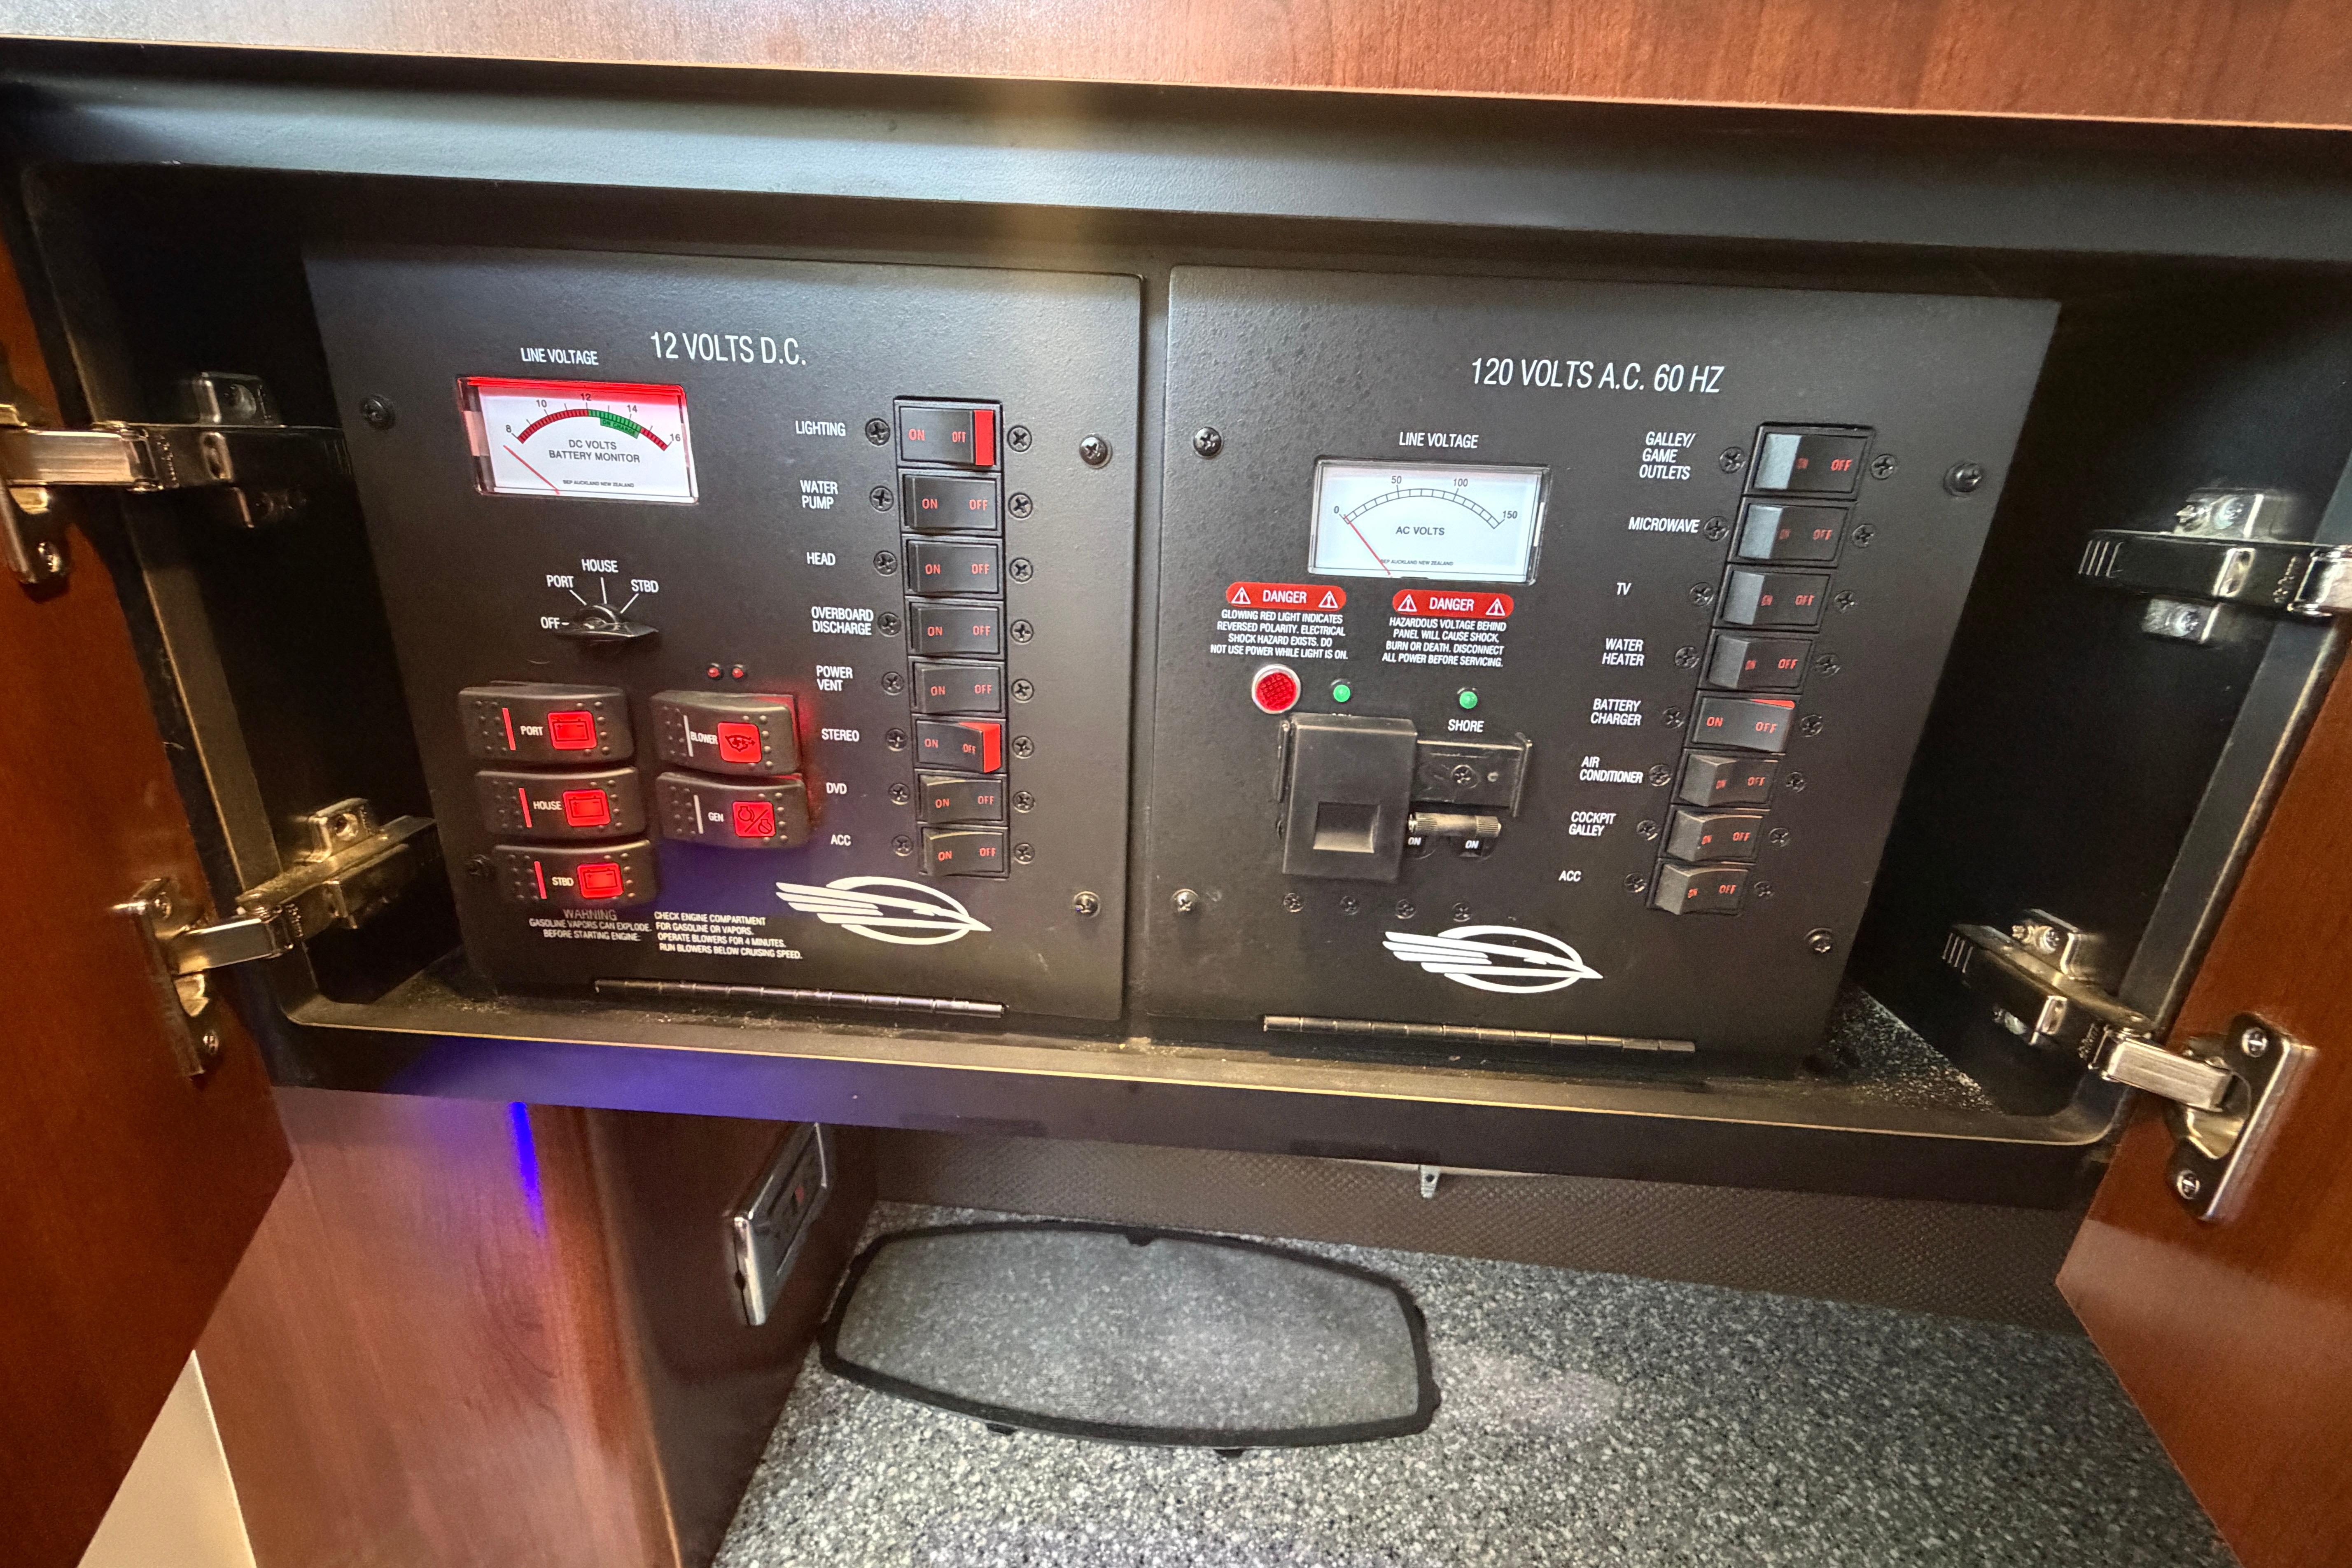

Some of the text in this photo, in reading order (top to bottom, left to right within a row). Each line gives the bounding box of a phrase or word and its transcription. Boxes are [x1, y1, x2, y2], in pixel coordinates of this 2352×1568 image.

[651, 332, 807, 366] 12 VOLTS D.C.
[521, 348, 598, 366] LINE VOLTAGE
[1472, 357, 1724, 393] 120 VOLTS A.C. 60 HZ
[795, 421, 846, 436] LIGHTING
[909, 429, 925, 441] ON
[569, 440, 616, 450] DC VOLTS
[1399, 432, 1479, 448] LINE VOLTAGE
[1646, 431, 1696, 448] GALLEY/
[549, 450, 640, 463] BATTERY MONITOR
[1643, 448, 1678, 463] GAME
[1831, 459, 1852, 471] OFF
[1639, 465, 1691, 480] OUTLETS
[1391, 476, 1402, 484] 50
[1453, 478, 1468, 487] 100
[800, 480, 838, 495] WATER
[802, 496, 833, 509] PUMP
[922, 499, 988, 511] ON OFF
[1334, 506, 1339, 514] 0
[1502, 510, 1517, 519] 150
[1396, 526, 1445, 535] AC VOLTS
[1628, 517, 1700, 533] MICROWAVE
[581, 559, 618, 573] HOUSE
[807, 552, 835, 566] HEAD
[925, 564, 989, 574] ON OFF
[546, 575, 574, 588] PORT
[631, 579, 659, 593] STBD
[1617, 582, 1632, 595] TV
[1263, 590, 1307, 604] DANGER
[1429, 597, 1474, 611] DANGER
[812, 607, 873, 621] OVERBOARD
[1222, 609, 1343, 623] GLOWING RED LIGHT INDICATES
[541, 616, 560, 629] OFF
[813, 621, 872, 635] DISCHARGE
[1217, 621, 1346, 636] REVERSED POLARITY. ELECTRICAL
[1389, 617, 1506, 631] HAZARDOUS VOLTAGE BEHIND
[927, 625, 990, 636] ON OFF
[1393, 629, 1500, 643] PANEL WILL CAUSE SHOCK,
[1228, 633, 1332, 647] SHOCK HAZARD EXISTS. DO
[1605, 638, 1643, 652] WATER
[1211, 644, 1348, 659] NOT USE POWER WHILE LIGHT IS ON.
[1386, 641, 1504, 655] BURN OR DEATH. DISCONNECT
[1382, 653, 1503, 667] ALL POWER BEFORE SERVICING.
[1602, 653, 1645, 666] HEATER
[816, 665, 853, 679] POWER
[817, 679, 843, 691] VENT
[931, 684, 992, 696] ON OFF
[1593, 698, 1641, 712] BATTERY
[1448, 719, 1484, 733] SHORE
[1590, 712, 1642, 726] CHARGER
[1706, 716, 1776, 733] ON OFF
[520, 726, 544, 736] PORT
[691, 731, 719, 744] BLOWER
[821, 728, 859, 742] STEREO
[924, 739, 976, 754] ON OFF
[1582, 756, 1599, 768] AIR
[1580, 770, 1643, 784] CONDITIONER
[826, 782, 847, 794] DVD
[533, 801, 562, 811] HOUSE
[935, 796, 994, 808] ON OFF
[708, 812, 724, 822] GEN
[1571, 811, 1616, 824] COCKPIT
[1569, 824, 1605, 837] GALLEY
[831, 834, 851, 846] ACC
[1408, 837, 1421, 845] ON
[1465, 840, 1479, 849] ON
[938, 847, 996, 861] ON OFF
[552, 877, 574, 887] STBD
[1559, 870, 1582, 882] ACC
[1719, 884, 1736, 894] OFF
[529, 918, 567, 928] GASOLINE
[567, 920, 597, 929] VAPORS
[599, 922, 615, 930] CAN
[654, 911, 766, 926] CHECK ENGINE COMPARTMENT
[543, 929, 610, 940] BEFORE STARTING
[656, 922, 754, 935] FOR GASOLINE OR VAPORS.
[658, 932, 690, 942] OPERATE
[692, 934, 727, 944] BLOWERS
[728, 936, 744, 945] FOR
[751, 938, 786, 948] MINUTES.
[659, 943, 803, 959] RUN BLOWERS BELOW CRUISING SPEED.
